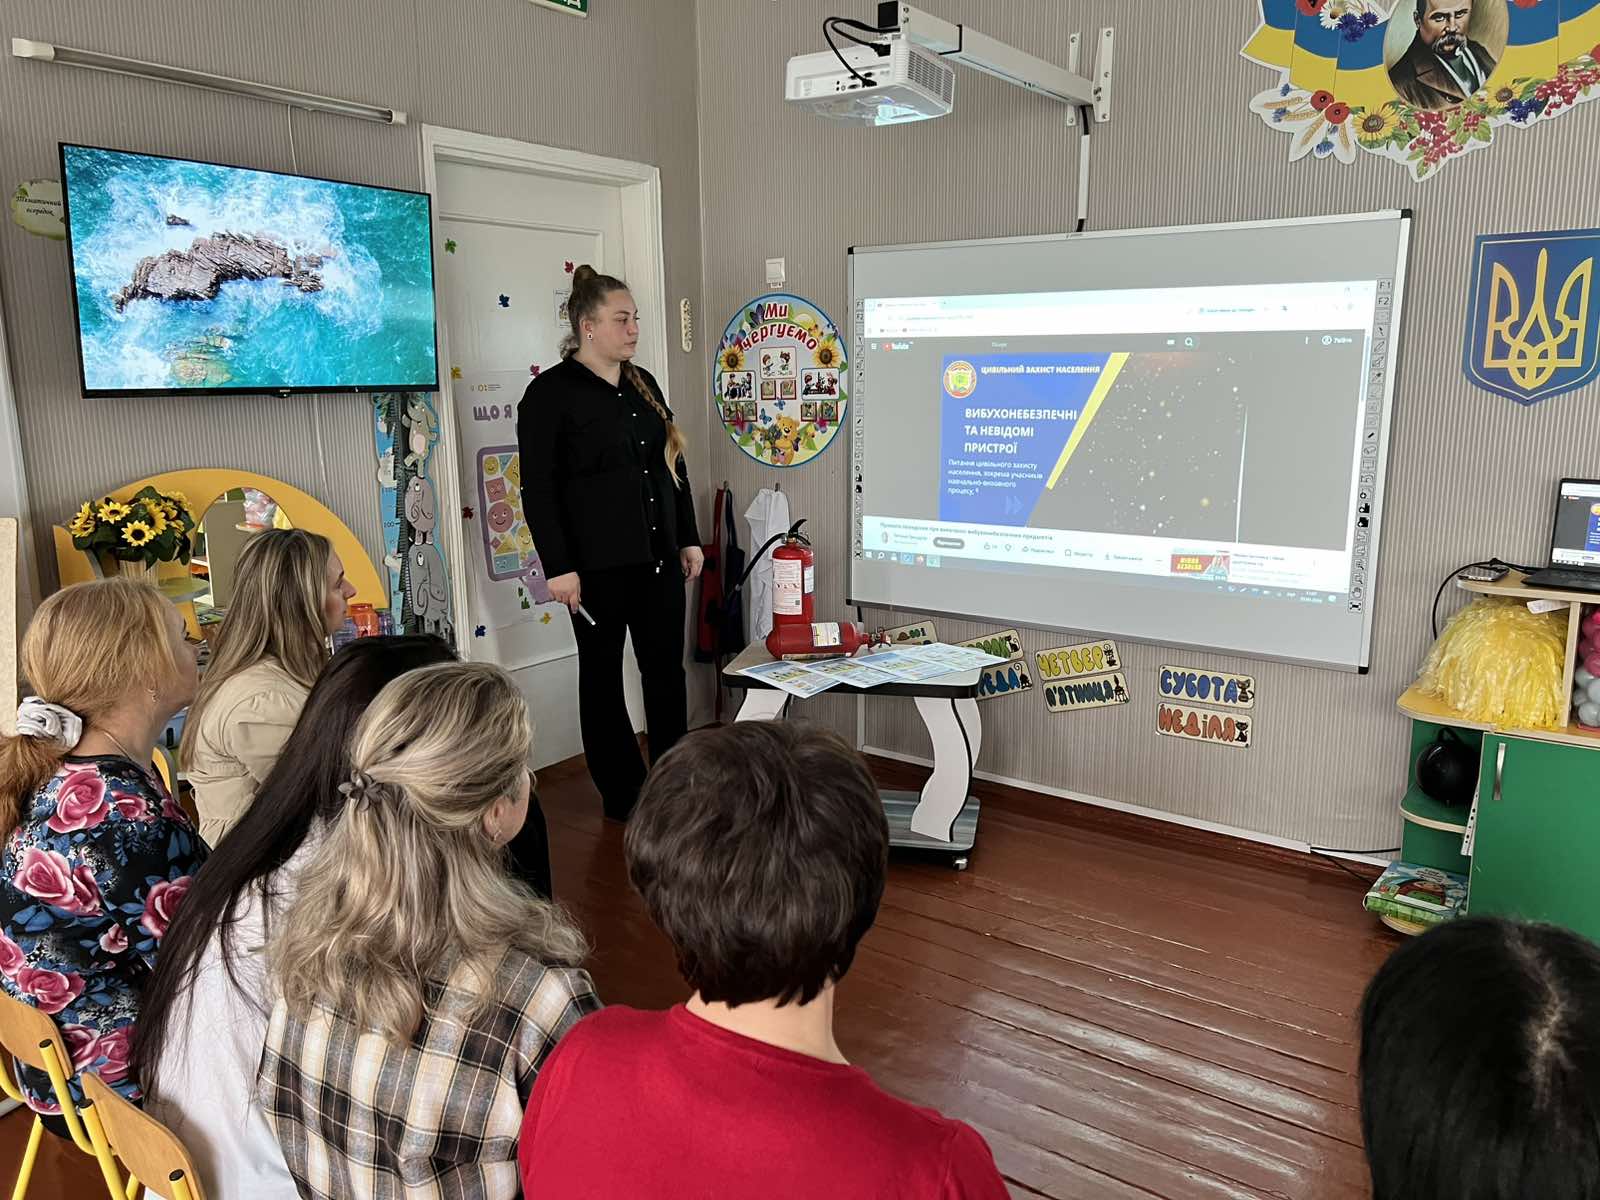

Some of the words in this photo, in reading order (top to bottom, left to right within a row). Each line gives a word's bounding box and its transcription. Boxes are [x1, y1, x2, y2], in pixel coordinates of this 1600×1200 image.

[764, 302, 789, 321] Ми
[981, 364, 1025, 375] ЦИВІЛЬНИЙ
[1026, 365, 1055, 375] ЗАХИСТ
[1056, 365, 1100, 375] НАСЕЛЕННЯ
[473, 404, 500, 421] ЩО
[964, 408, 1077, 421] ВИБУХОНЕБЕЗПЕЧНІ
[964, 425, 978, 436] ТА
[980, 426, 1034, 438] НЕВІДОМІ
[964, 442, 1018, 454] ПРИСТРОЇ
[1039, 645, 1104, 678] ЧЕТВЕР
[1160, 669, 1238, 704] СУБОТА
